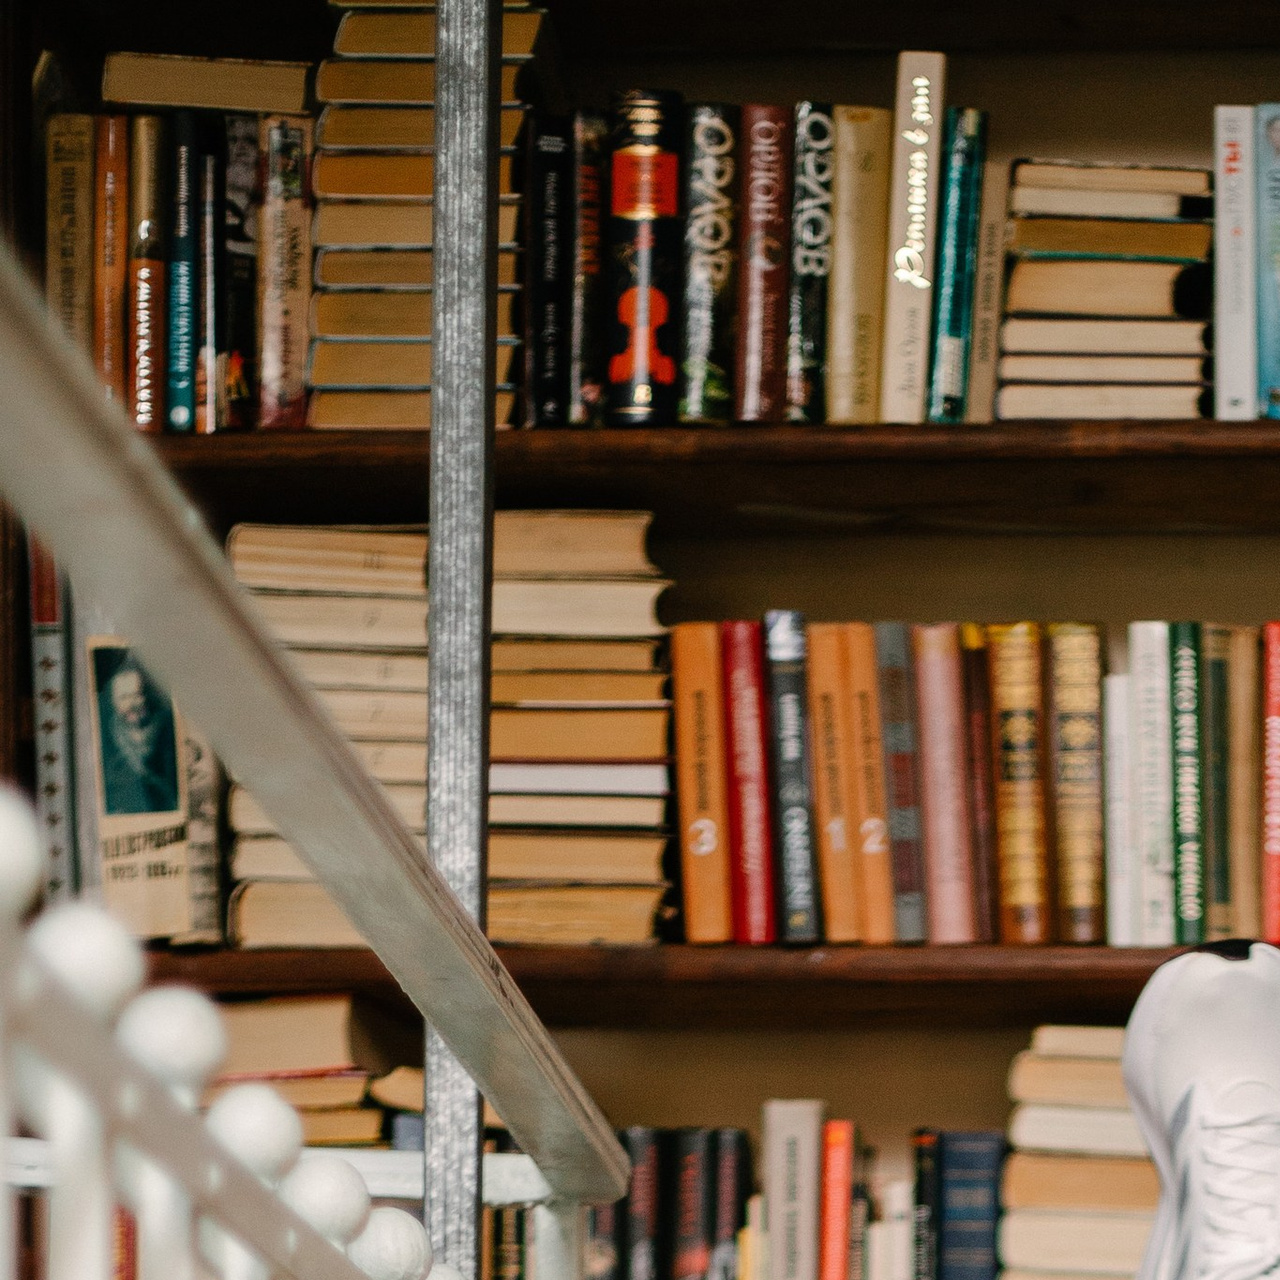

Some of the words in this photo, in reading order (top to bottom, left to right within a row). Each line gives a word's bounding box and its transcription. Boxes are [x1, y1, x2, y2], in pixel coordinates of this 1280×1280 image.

[691, 117, 735, 282] ОРЛОВ
[794, 112, 834, 276] ОРЛОВ
[688, 819, 718, 856] 3
[825, 820, 847, 852] 1
[860, 818, 888, 855] 2
